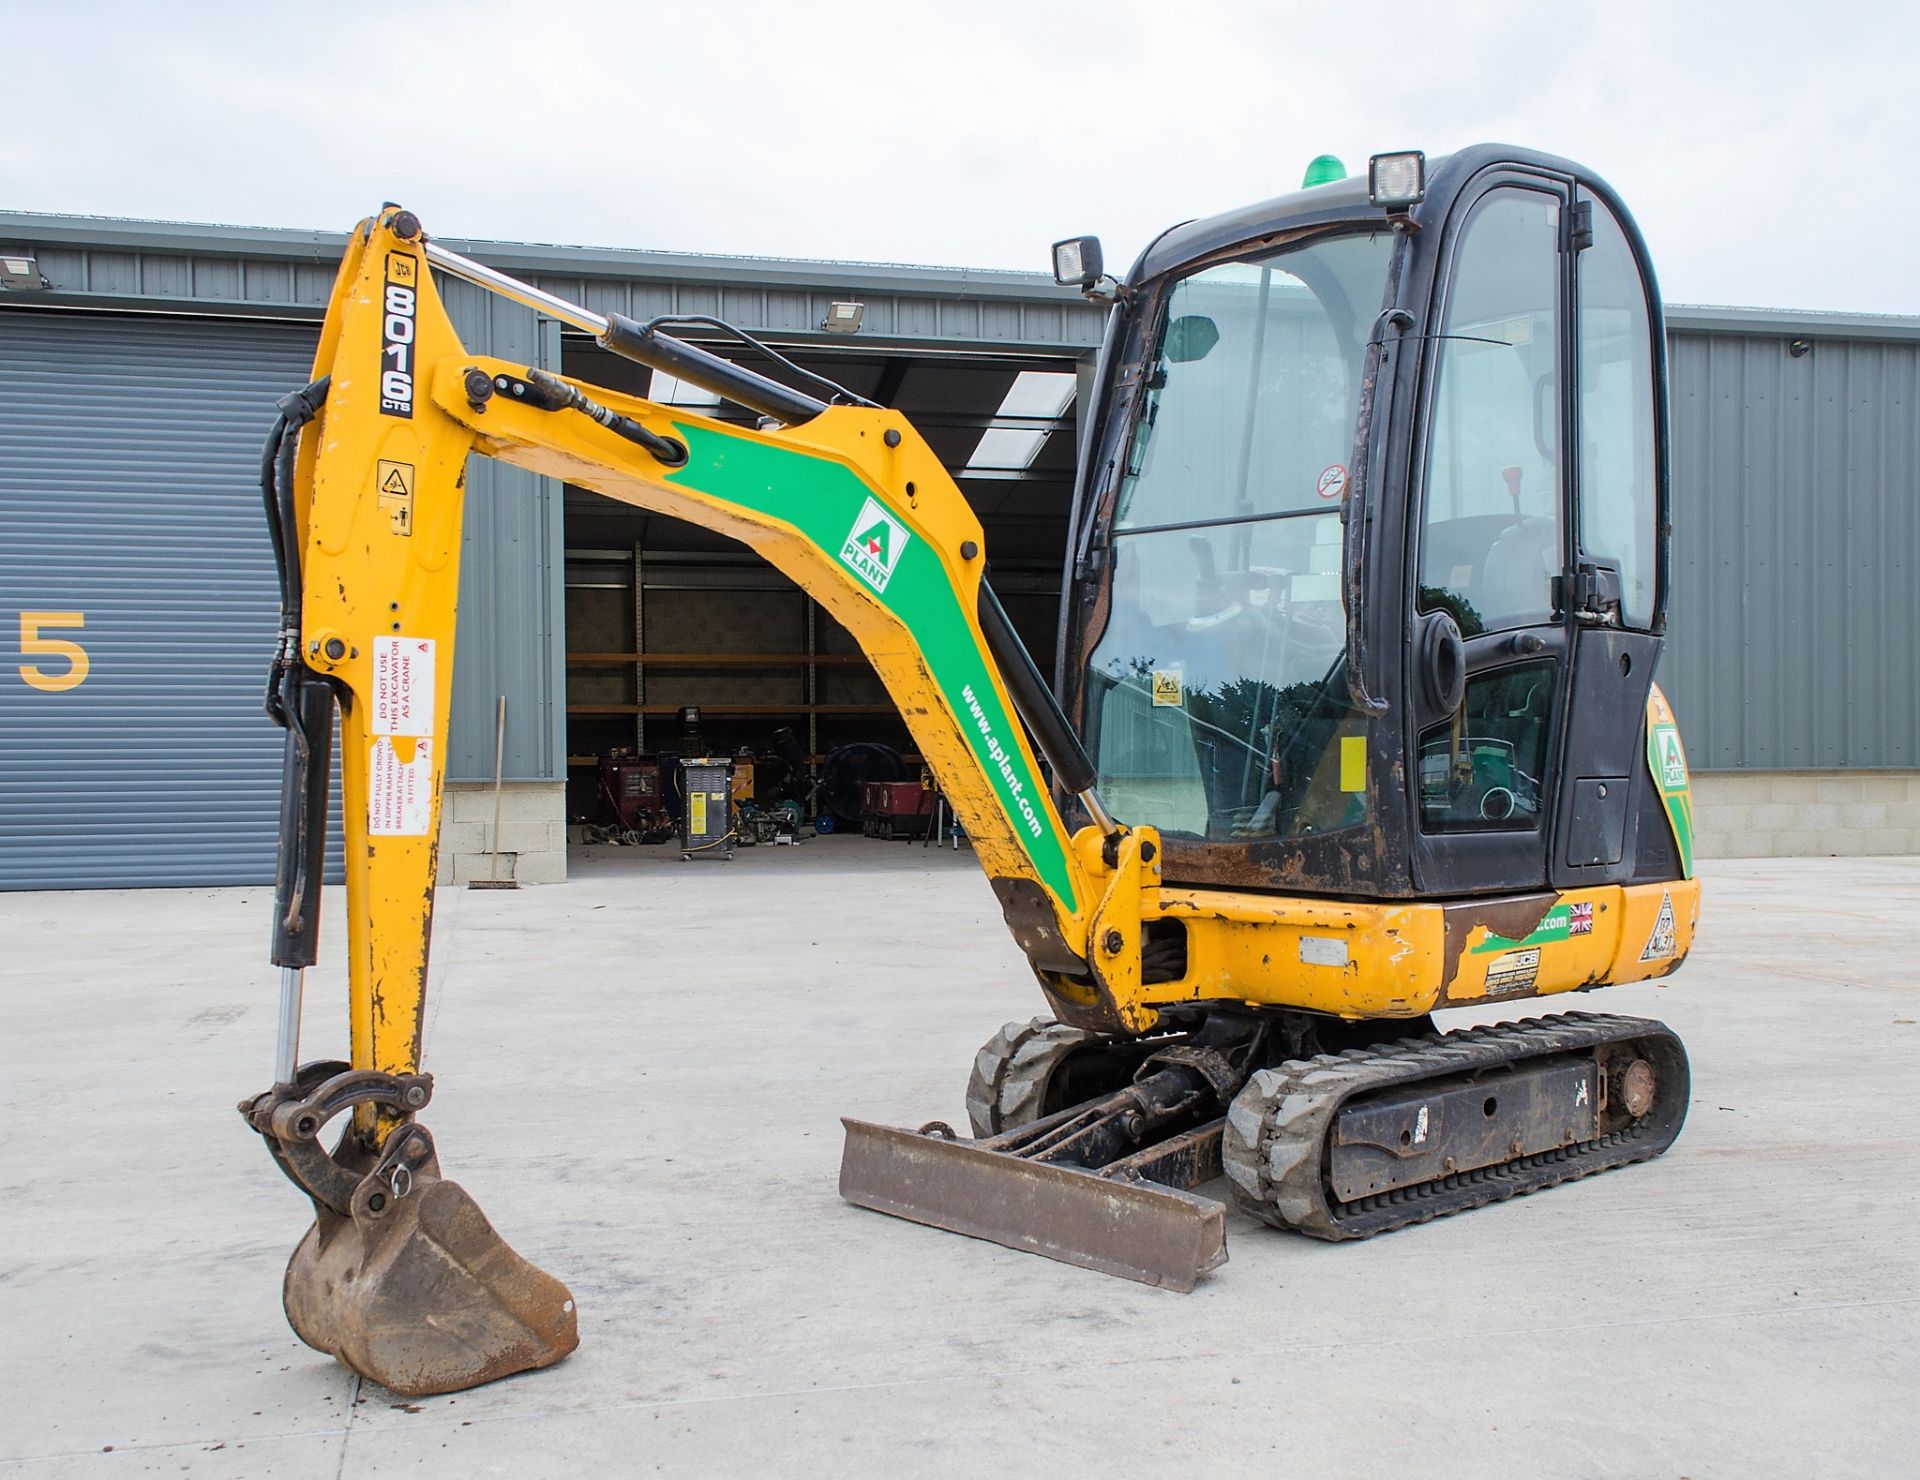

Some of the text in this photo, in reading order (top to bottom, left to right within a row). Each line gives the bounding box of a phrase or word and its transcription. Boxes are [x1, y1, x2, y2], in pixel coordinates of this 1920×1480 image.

[382, 285, 415, 402] 8016
[382, 398, 411, 412] CTS
[843, 542, 888, 587] PLANT
[19, 611, 90, 692] 5
[379, 652, 388, 719] DO NOT USE
[390, 640, 400, 732] THIS EXCAVATOR
[402, 655, 411, 719] AS A CRANE
[376, 740, 384, 772] CROWD
[961, 683, 1043, 839] www.aplant.com
[374, 798, 382, 815] NOT
[385, 790, 393, 820] DIPPER
[395, 794, 403, 830] BREAKER
[407, 797, 414, 805] IS
[374, 817, 381, 829] DO
[385, 819, 391, 829] IN
